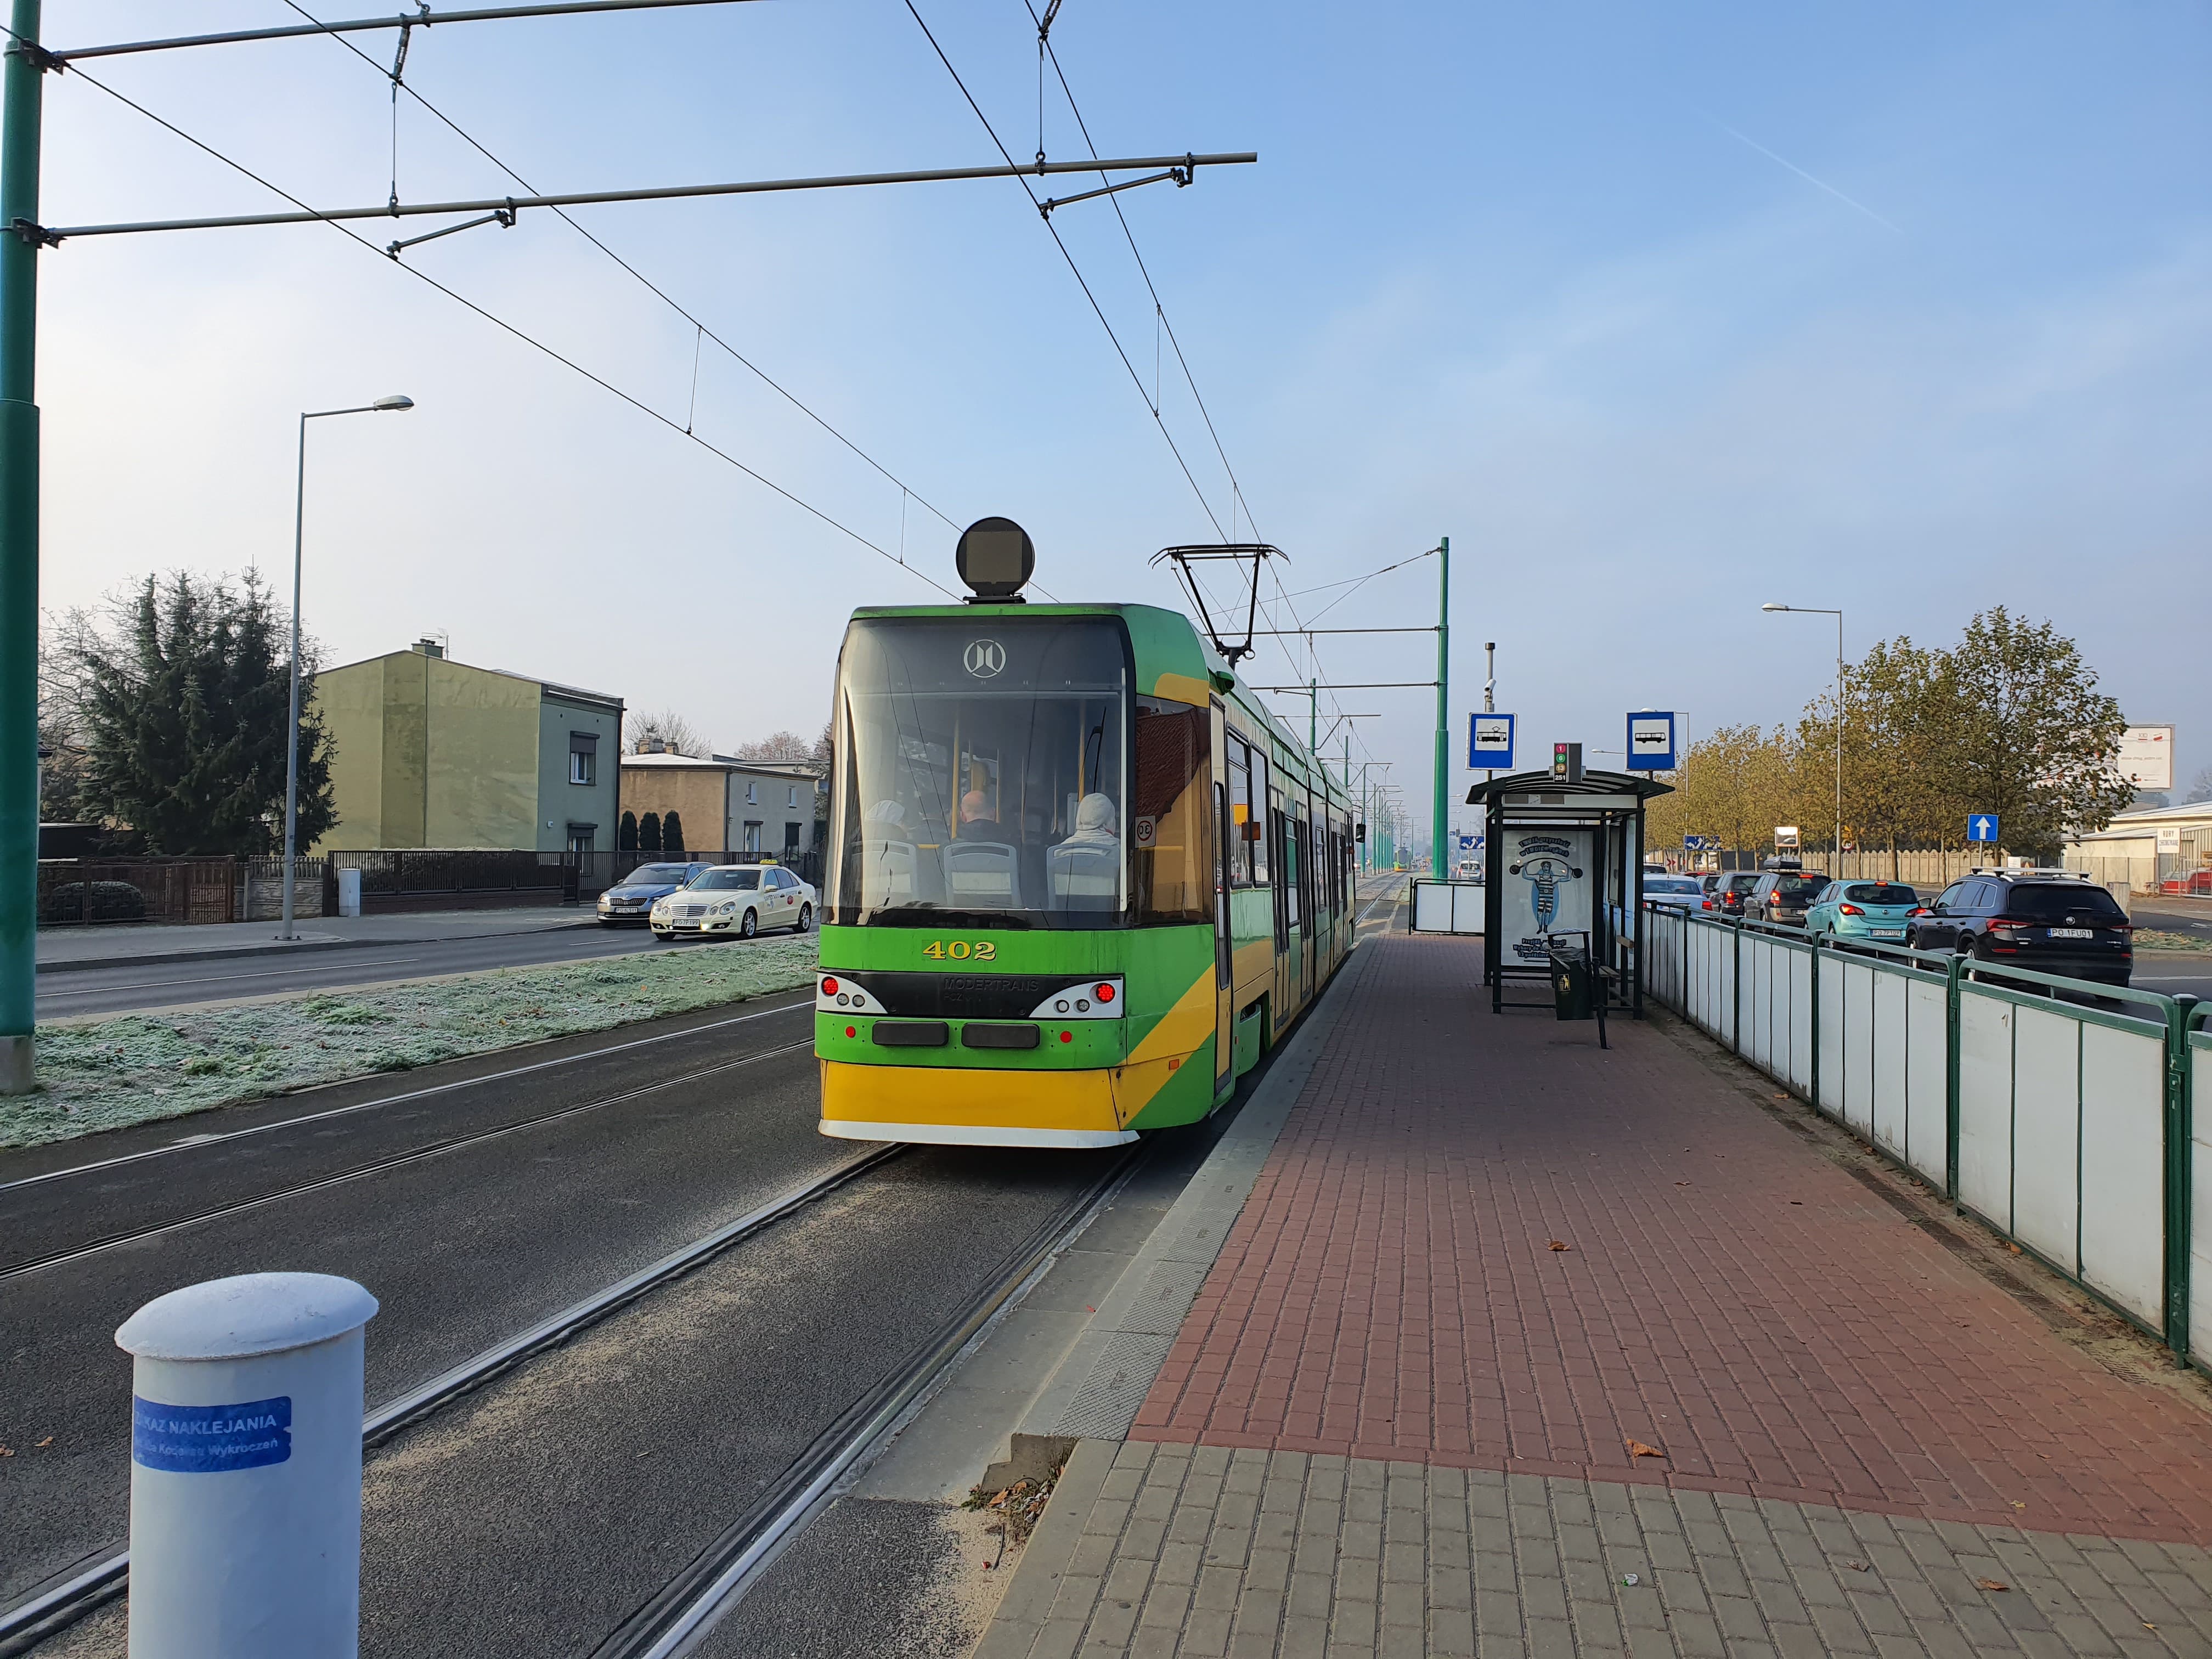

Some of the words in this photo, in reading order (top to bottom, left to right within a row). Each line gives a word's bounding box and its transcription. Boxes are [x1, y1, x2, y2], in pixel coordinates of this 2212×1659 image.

[923, 940, 996, 961] 402
[944, 978, 1039, 991] MODERTRANS
[169, 1414, 276, 1435] NAKLEJANIA
[208, 1437, 278, 1458] Wykroczeń
